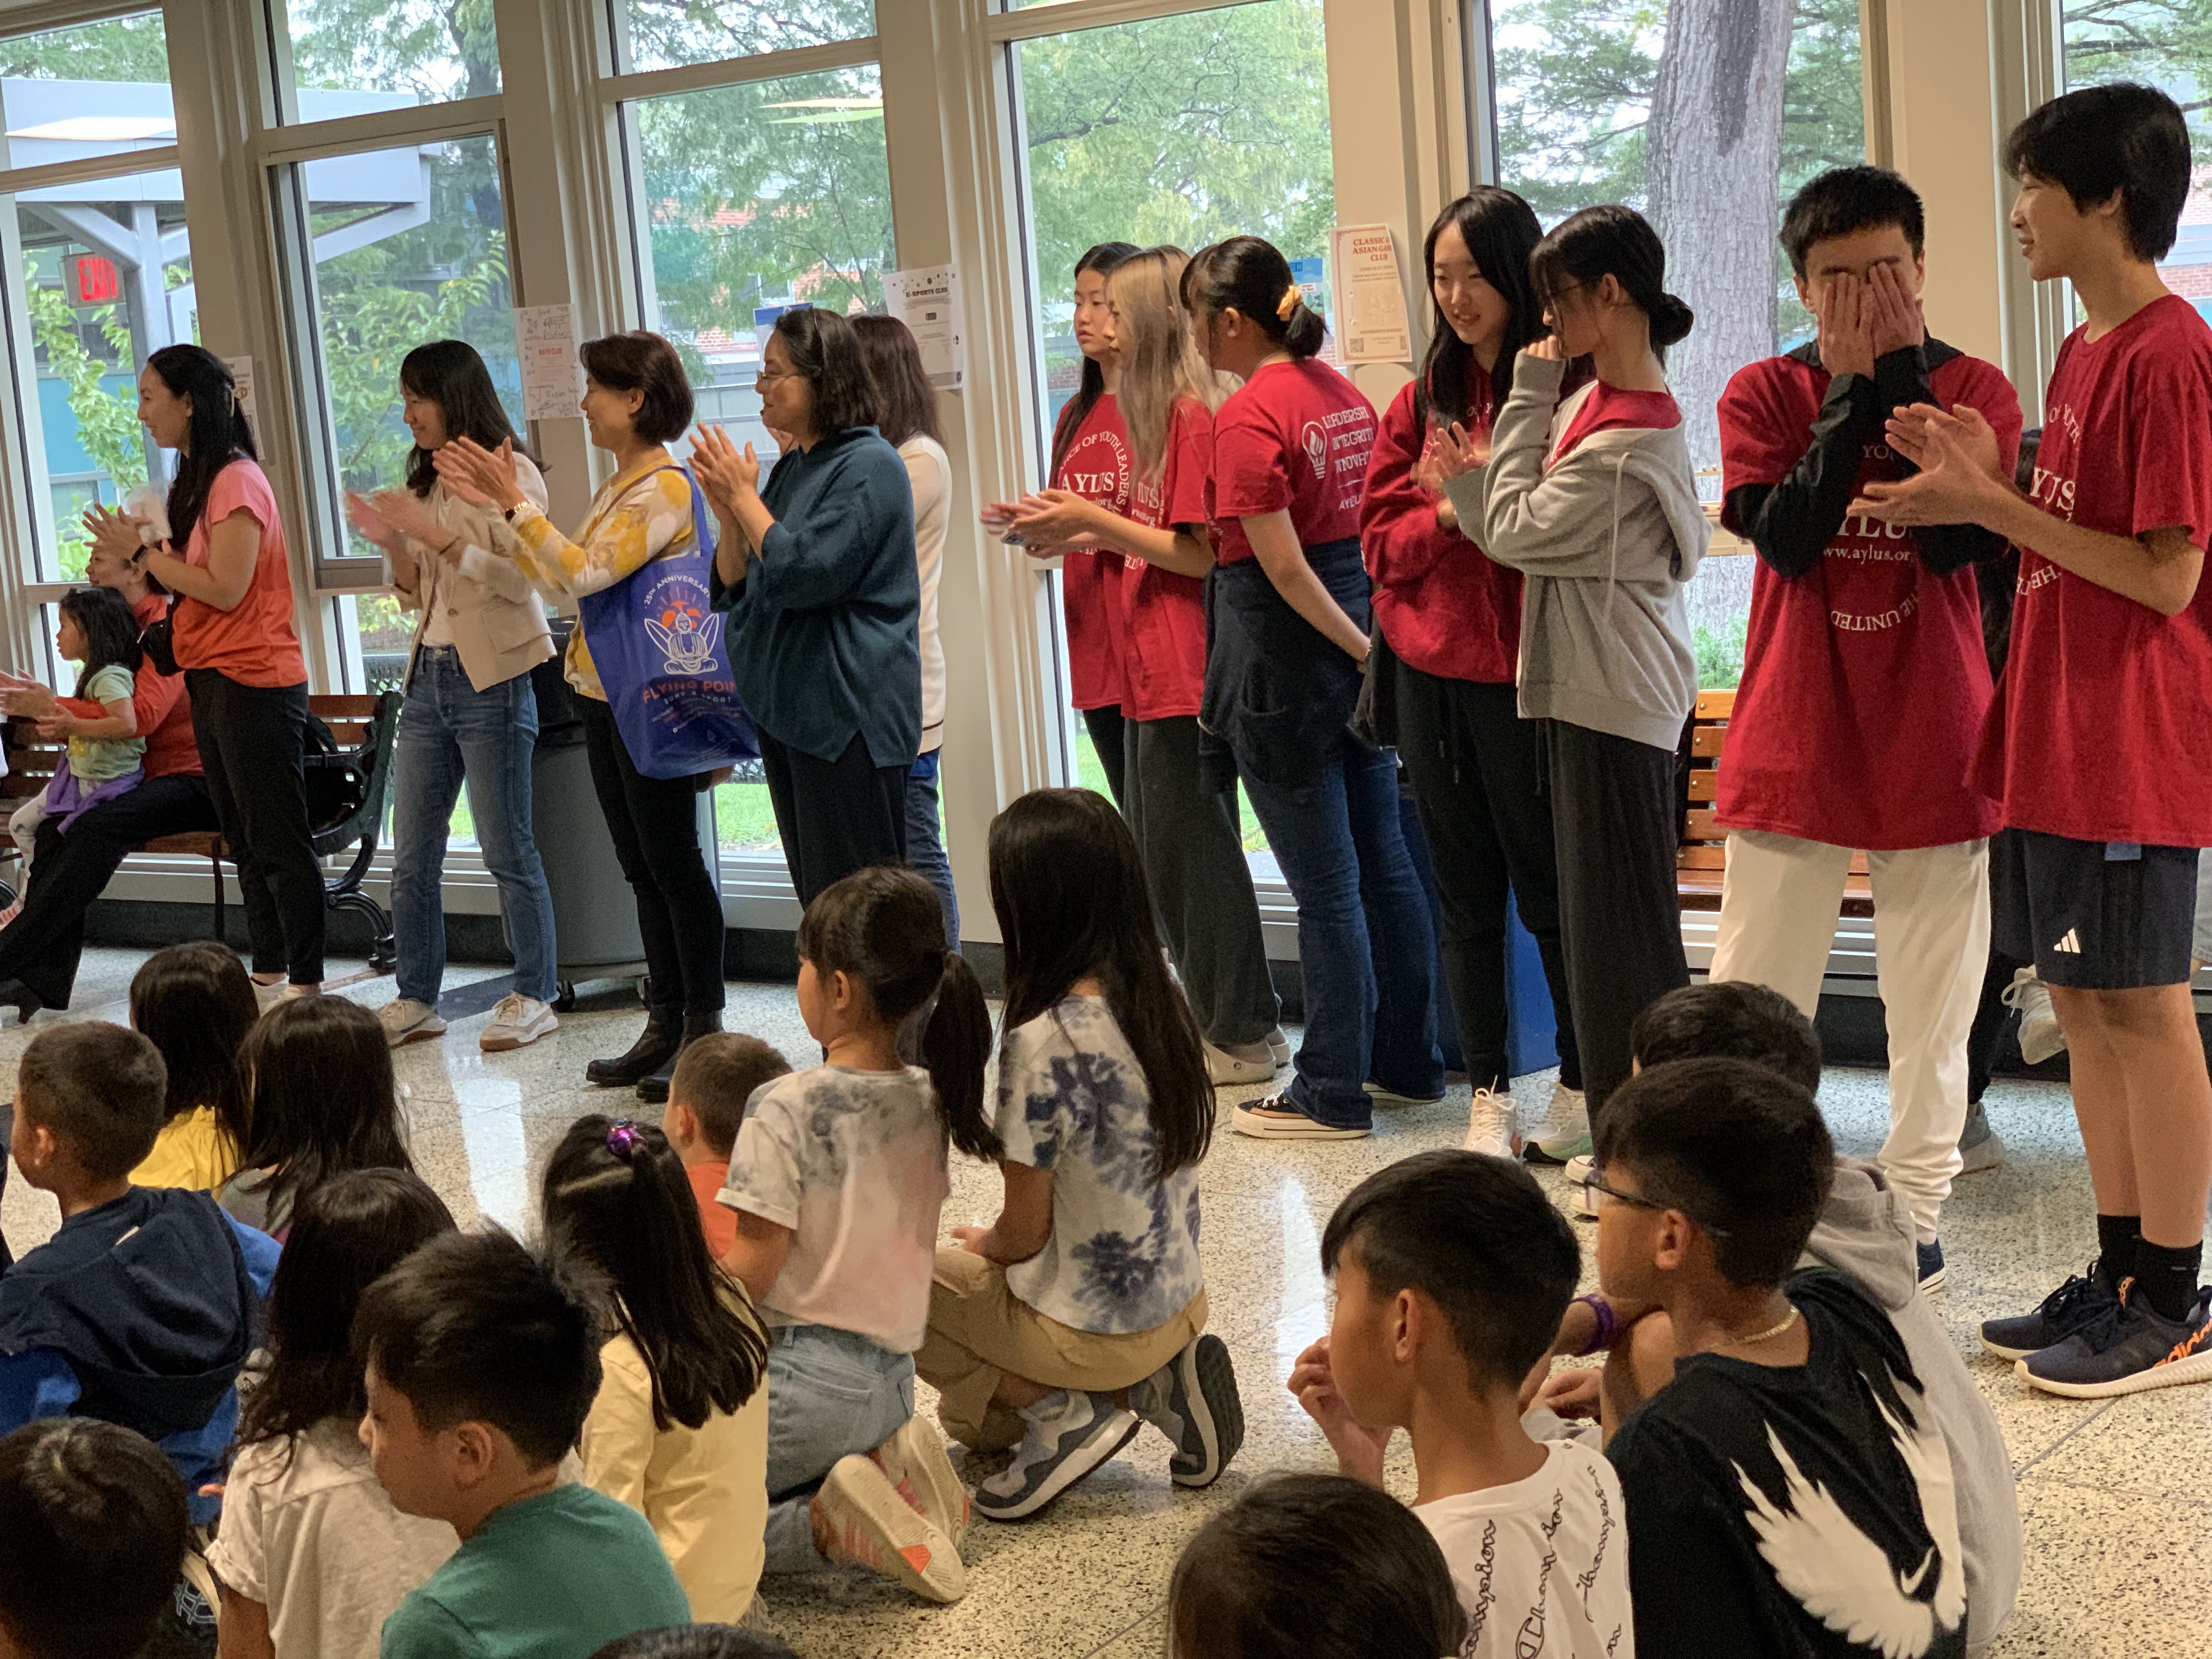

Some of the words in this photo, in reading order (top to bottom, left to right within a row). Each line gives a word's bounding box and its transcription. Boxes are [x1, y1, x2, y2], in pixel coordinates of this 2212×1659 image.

[1353, 246, 1378, 255] ASIAN
[77, 257, 117, 301] EXIT
[906, 289, 934, 298] E-SPORTS
[1082, 434, 1098, 447] OF
[1099, 431, 1121, 451] YOUTH
[1115, 448, 1130, 506] LEADERS
[1831, 610, 1901, 631] UNITED
[643, 680, 697, 703] FLYING
